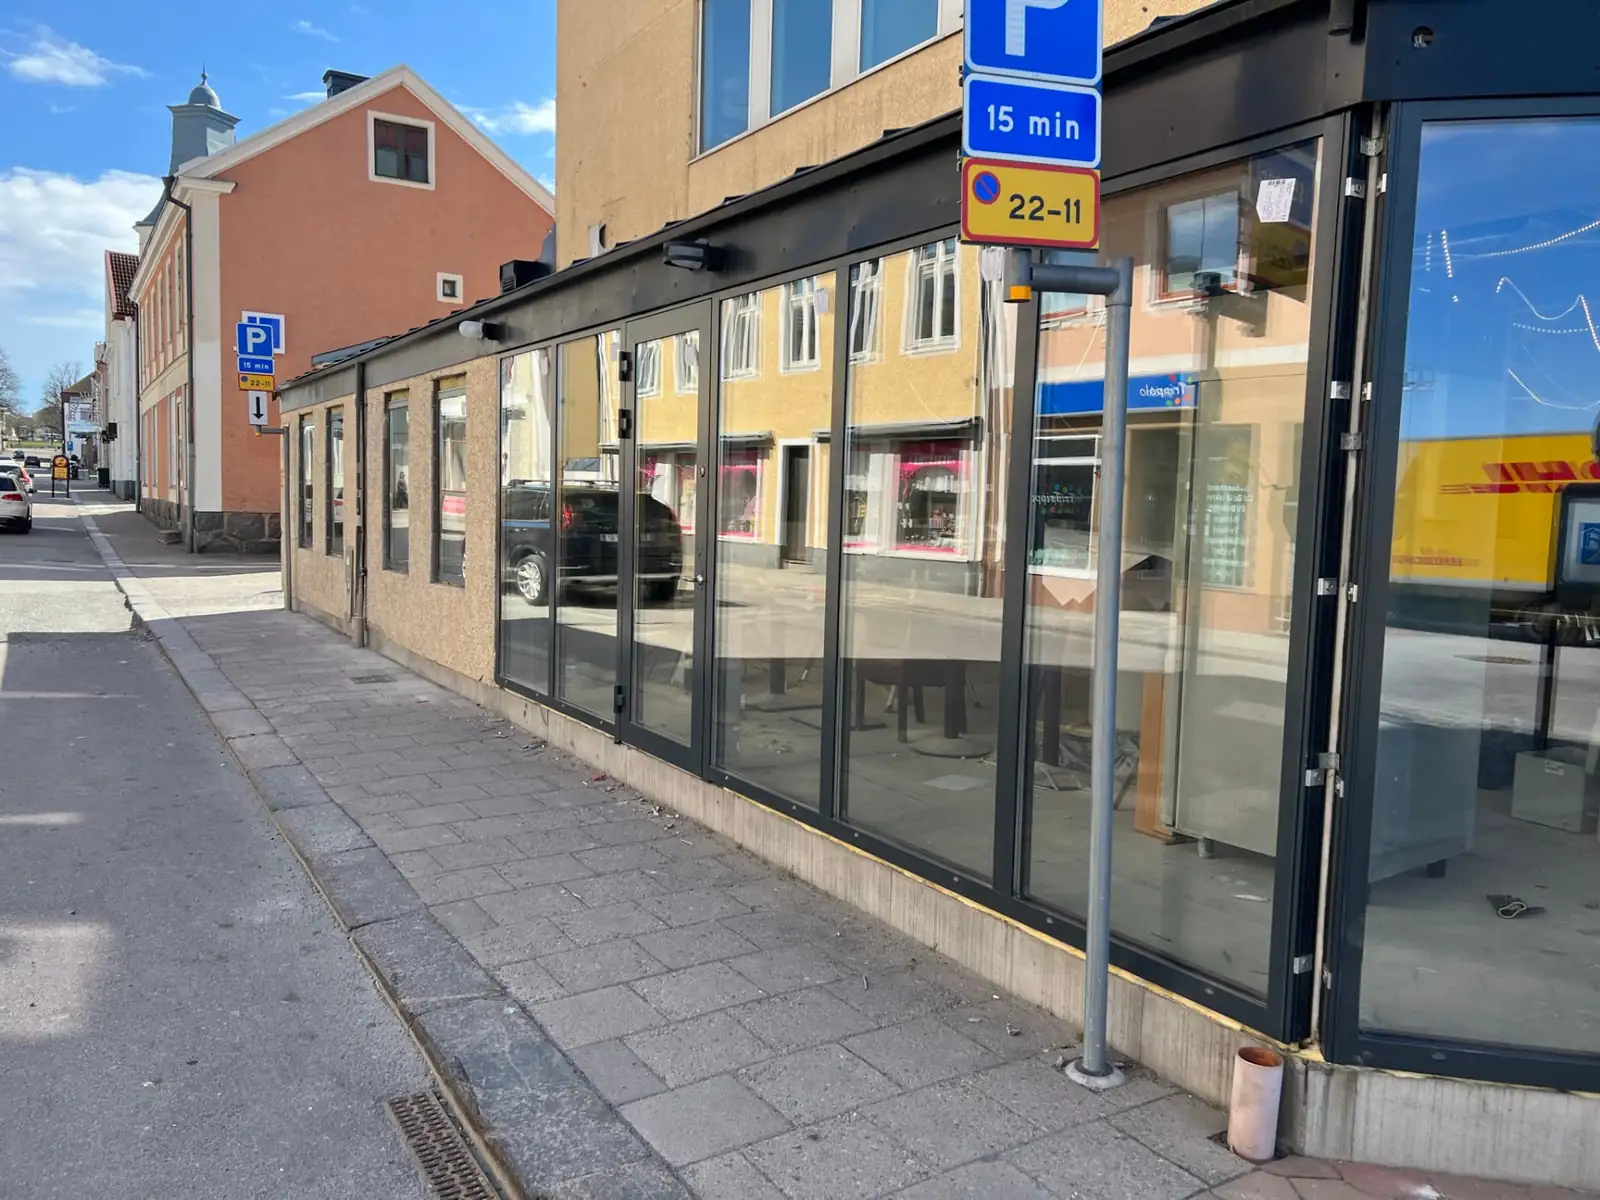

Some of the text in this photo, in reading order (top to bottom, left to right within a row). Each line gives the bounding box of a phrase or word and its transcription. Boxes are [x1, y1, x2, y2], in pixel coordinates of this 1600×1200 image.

[987, 104, 1080, 140] 15 min
[1008, 193, 1081, 224] 22-11
[246, 326, 267, 353] P
[243, 361, 269, 370] 15 min
[250, 379, 270, 387] 22-11
